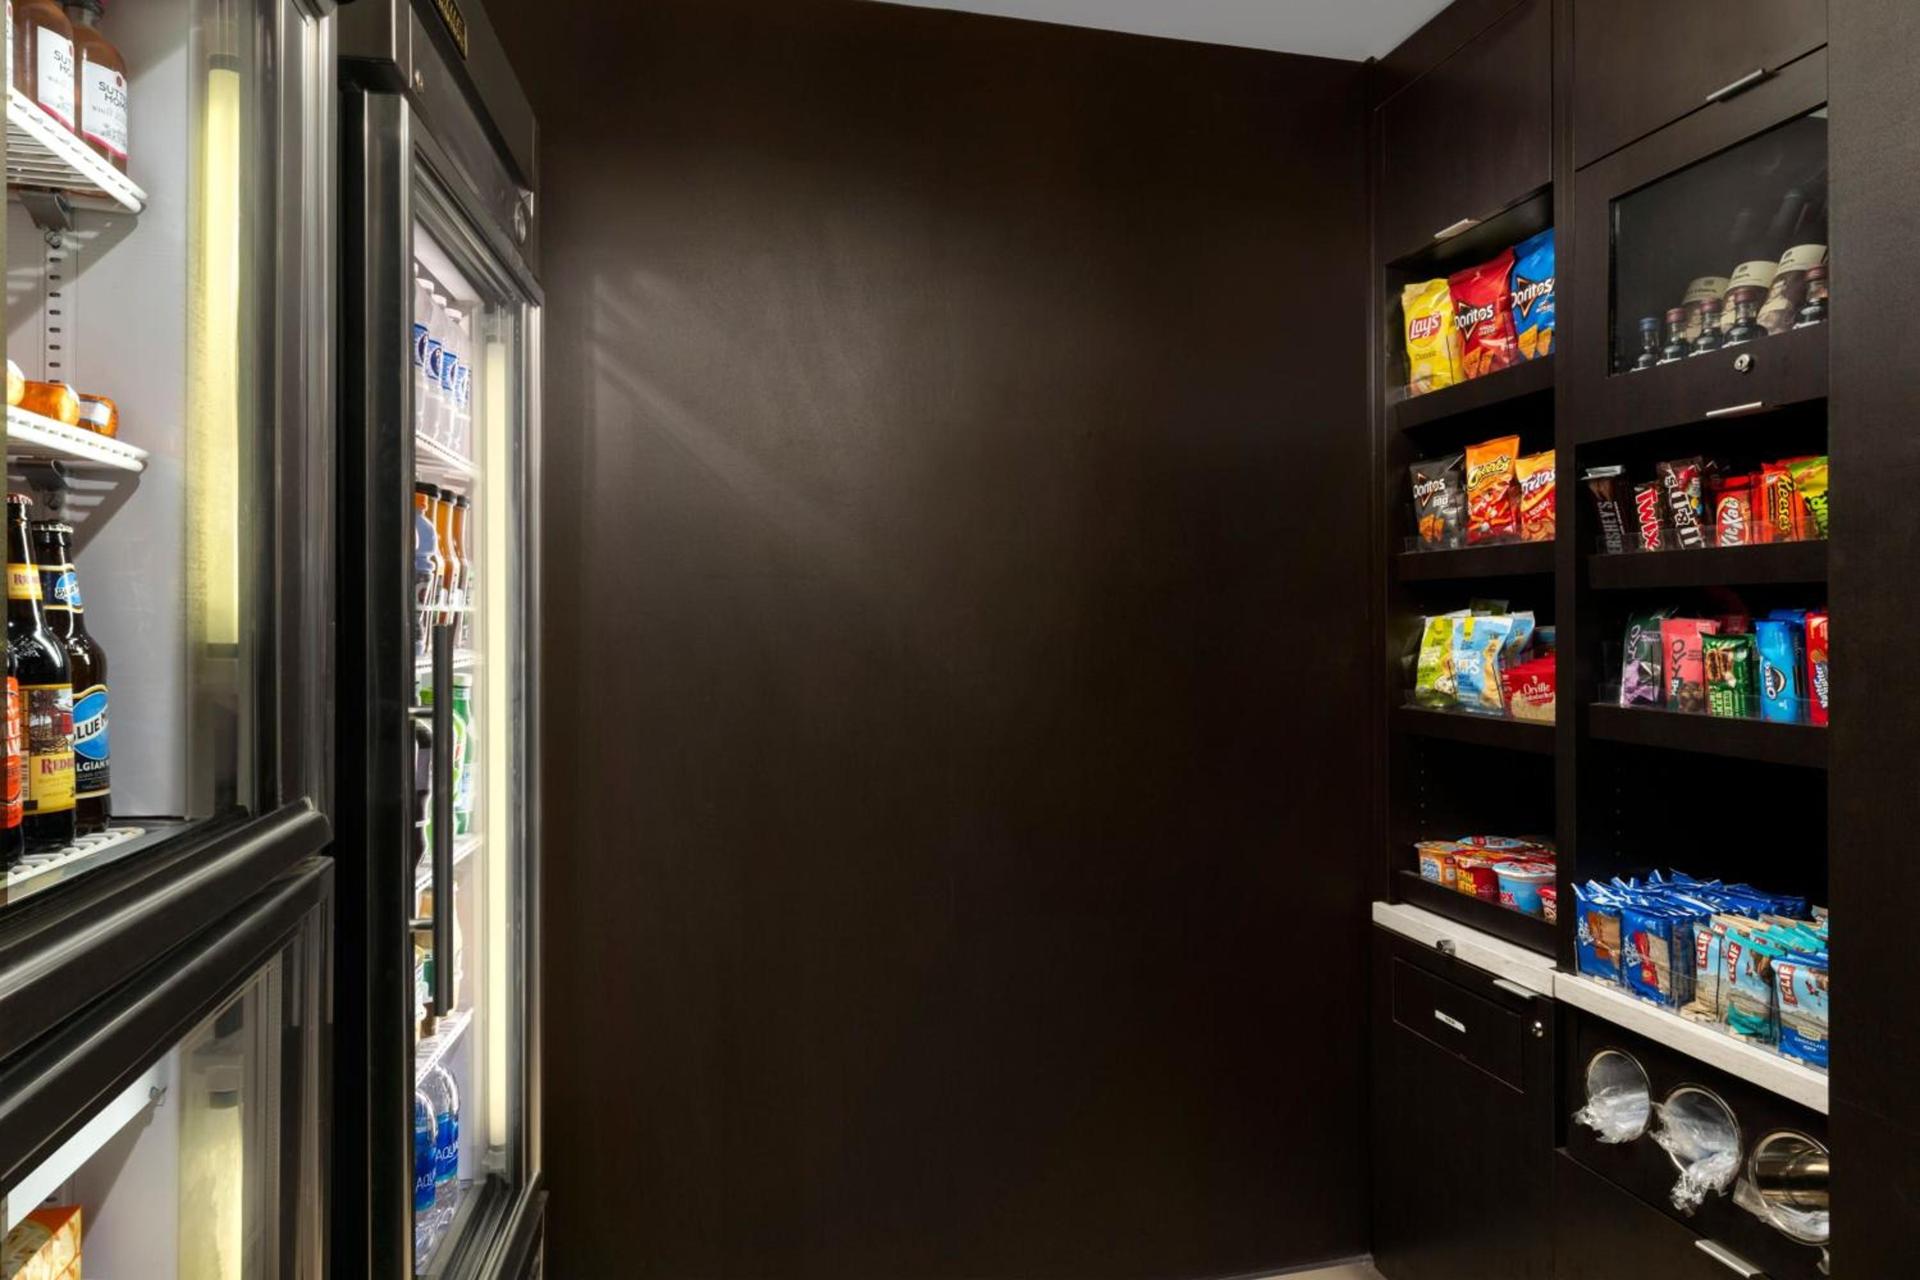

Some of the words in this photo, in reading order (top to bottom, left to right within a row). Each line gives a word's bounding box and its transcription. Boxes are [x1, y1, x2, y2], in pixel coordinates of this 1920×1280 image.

[1413, 477, 1446, 499] Doritos
[1467, 456, 1510, 490] Cheetos
[1597, 501, 1622, 554] ERSHEY'S
